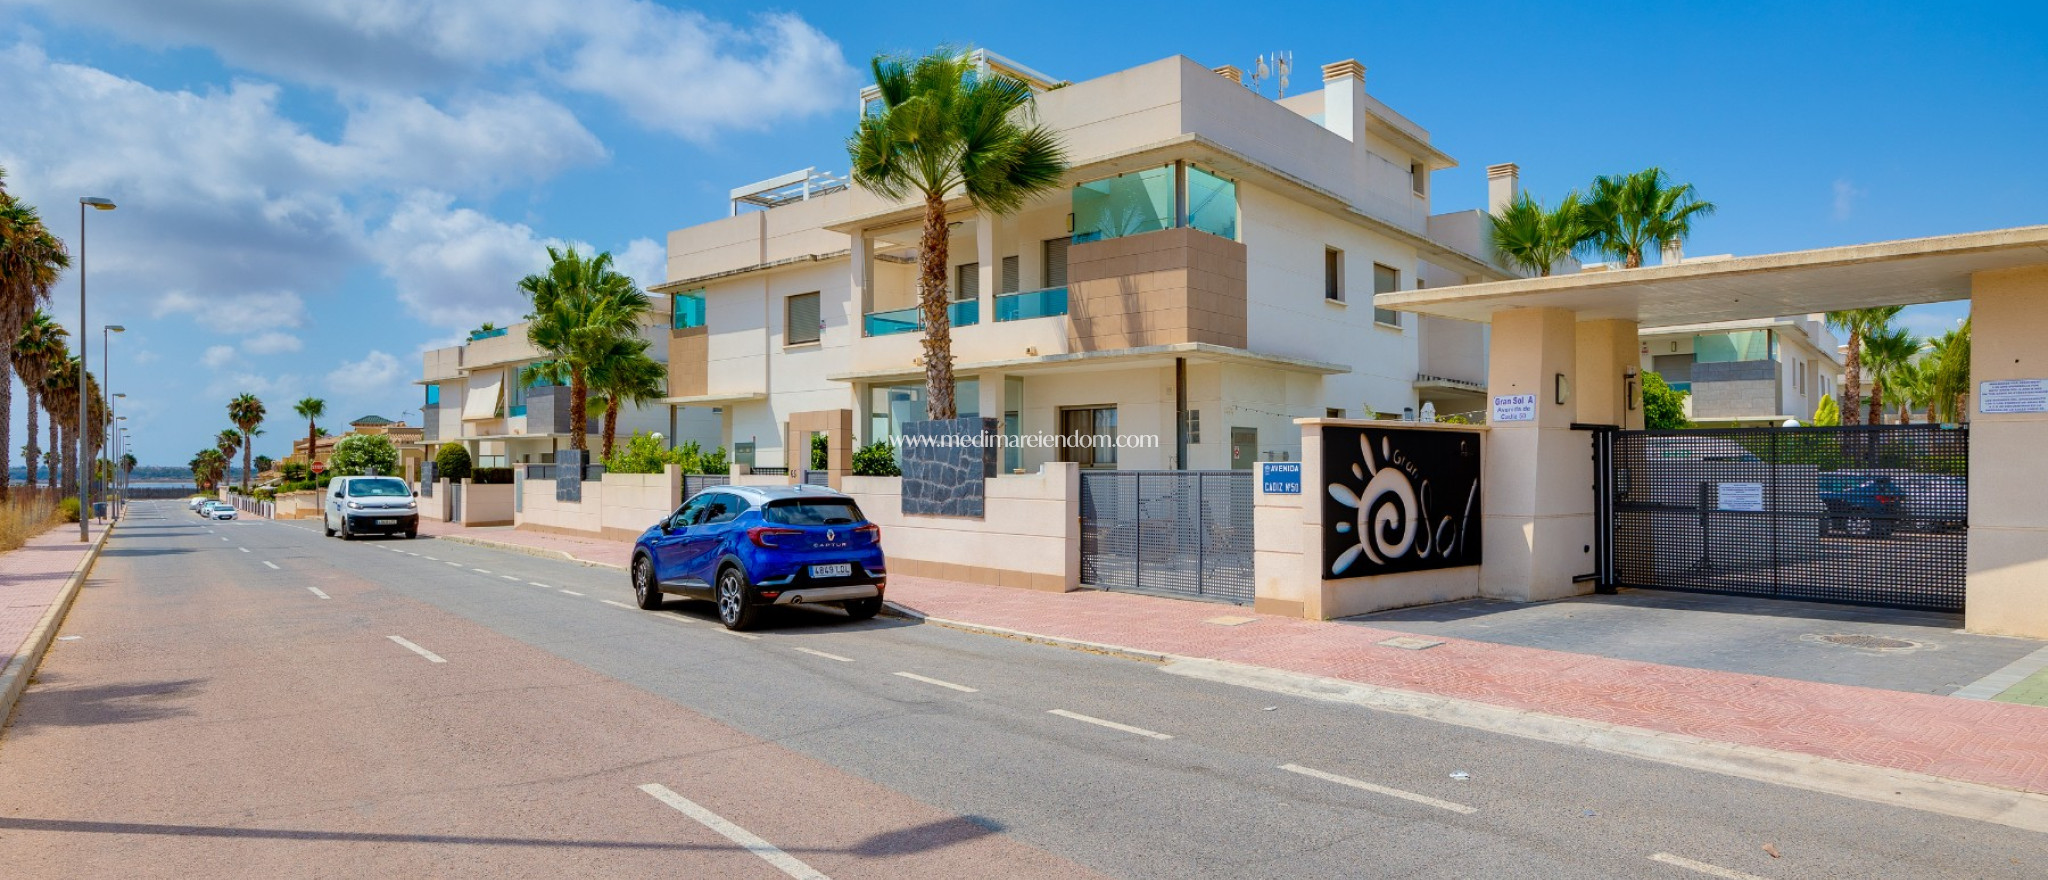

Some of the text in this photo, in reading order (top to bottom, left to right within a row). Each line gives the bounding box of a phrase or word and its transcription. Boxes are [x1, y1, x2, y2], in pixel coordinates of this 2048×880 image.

[1393, 449, 1419, 479] Gran
[1415, 477, 1478, 559] Sol
[814, 566, 834, 575] 4849
